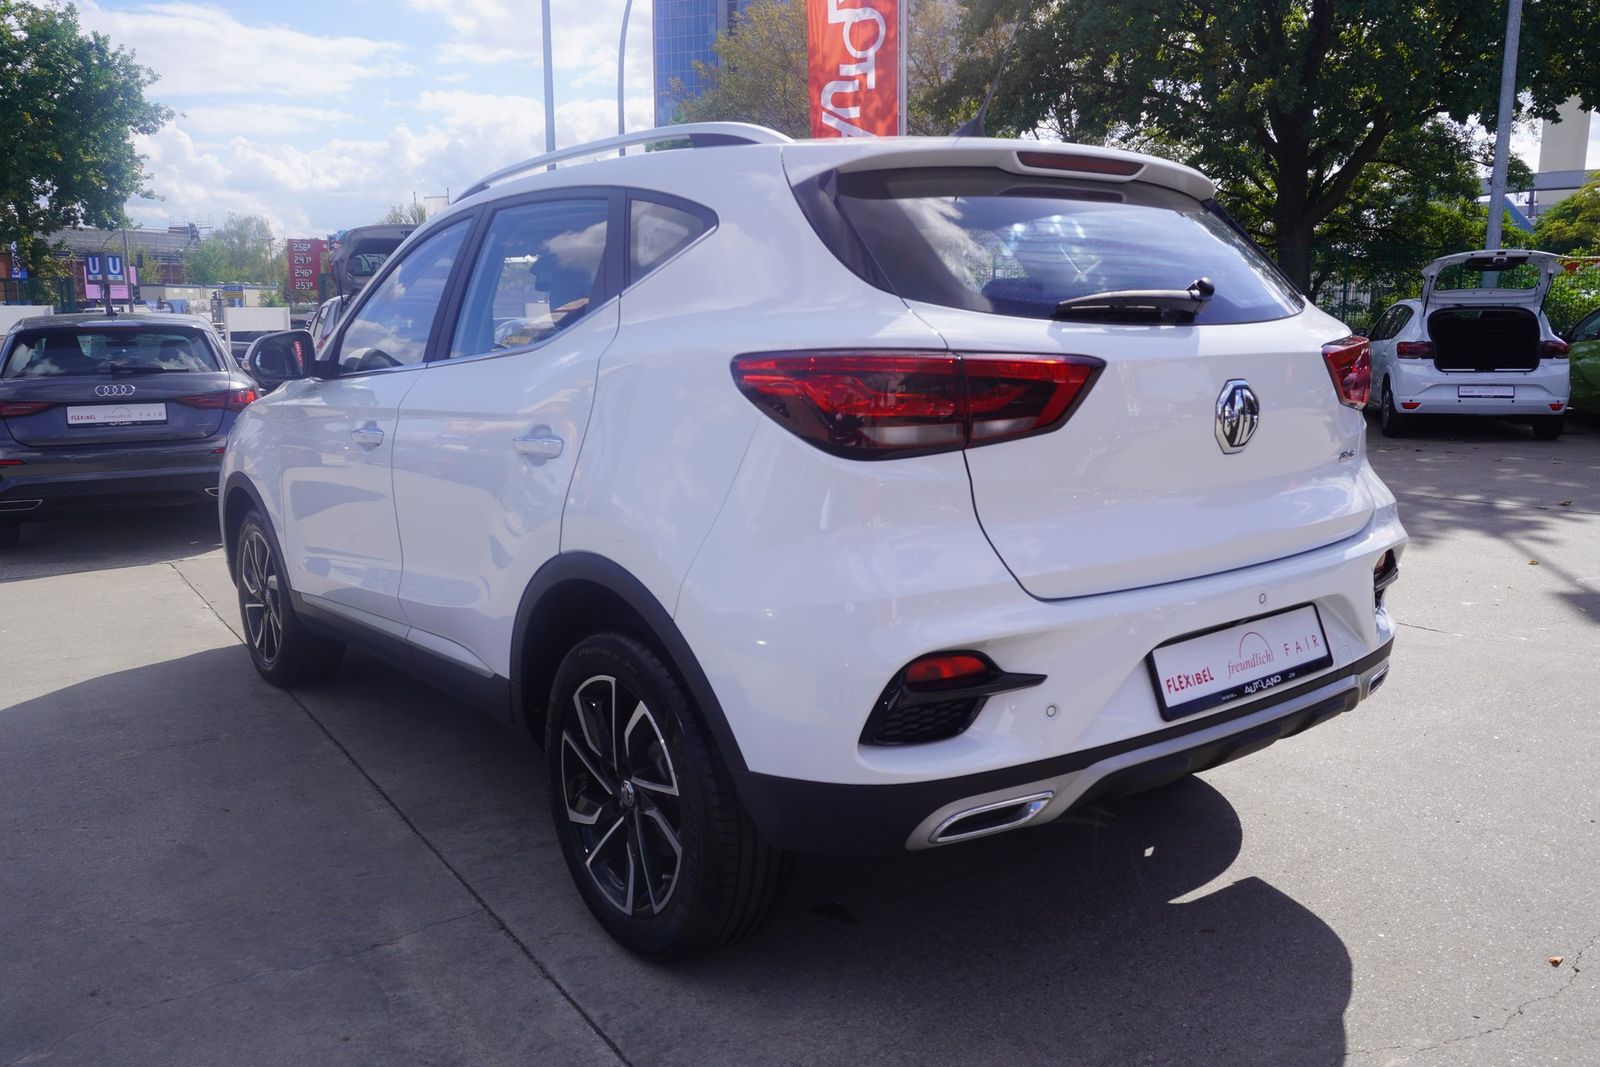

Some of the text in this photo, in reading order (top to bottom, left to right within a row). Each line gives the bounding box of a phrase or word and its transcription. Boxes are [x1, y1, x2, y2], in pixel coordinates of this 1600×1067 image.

[88, 257, 99, 274] U
[108, 257, 120, 274] U
[1166, 634, 1319, 693] FLEXIBEL freundlich FAIR
[1244, 675, 1281, 694] AUTOLAND
